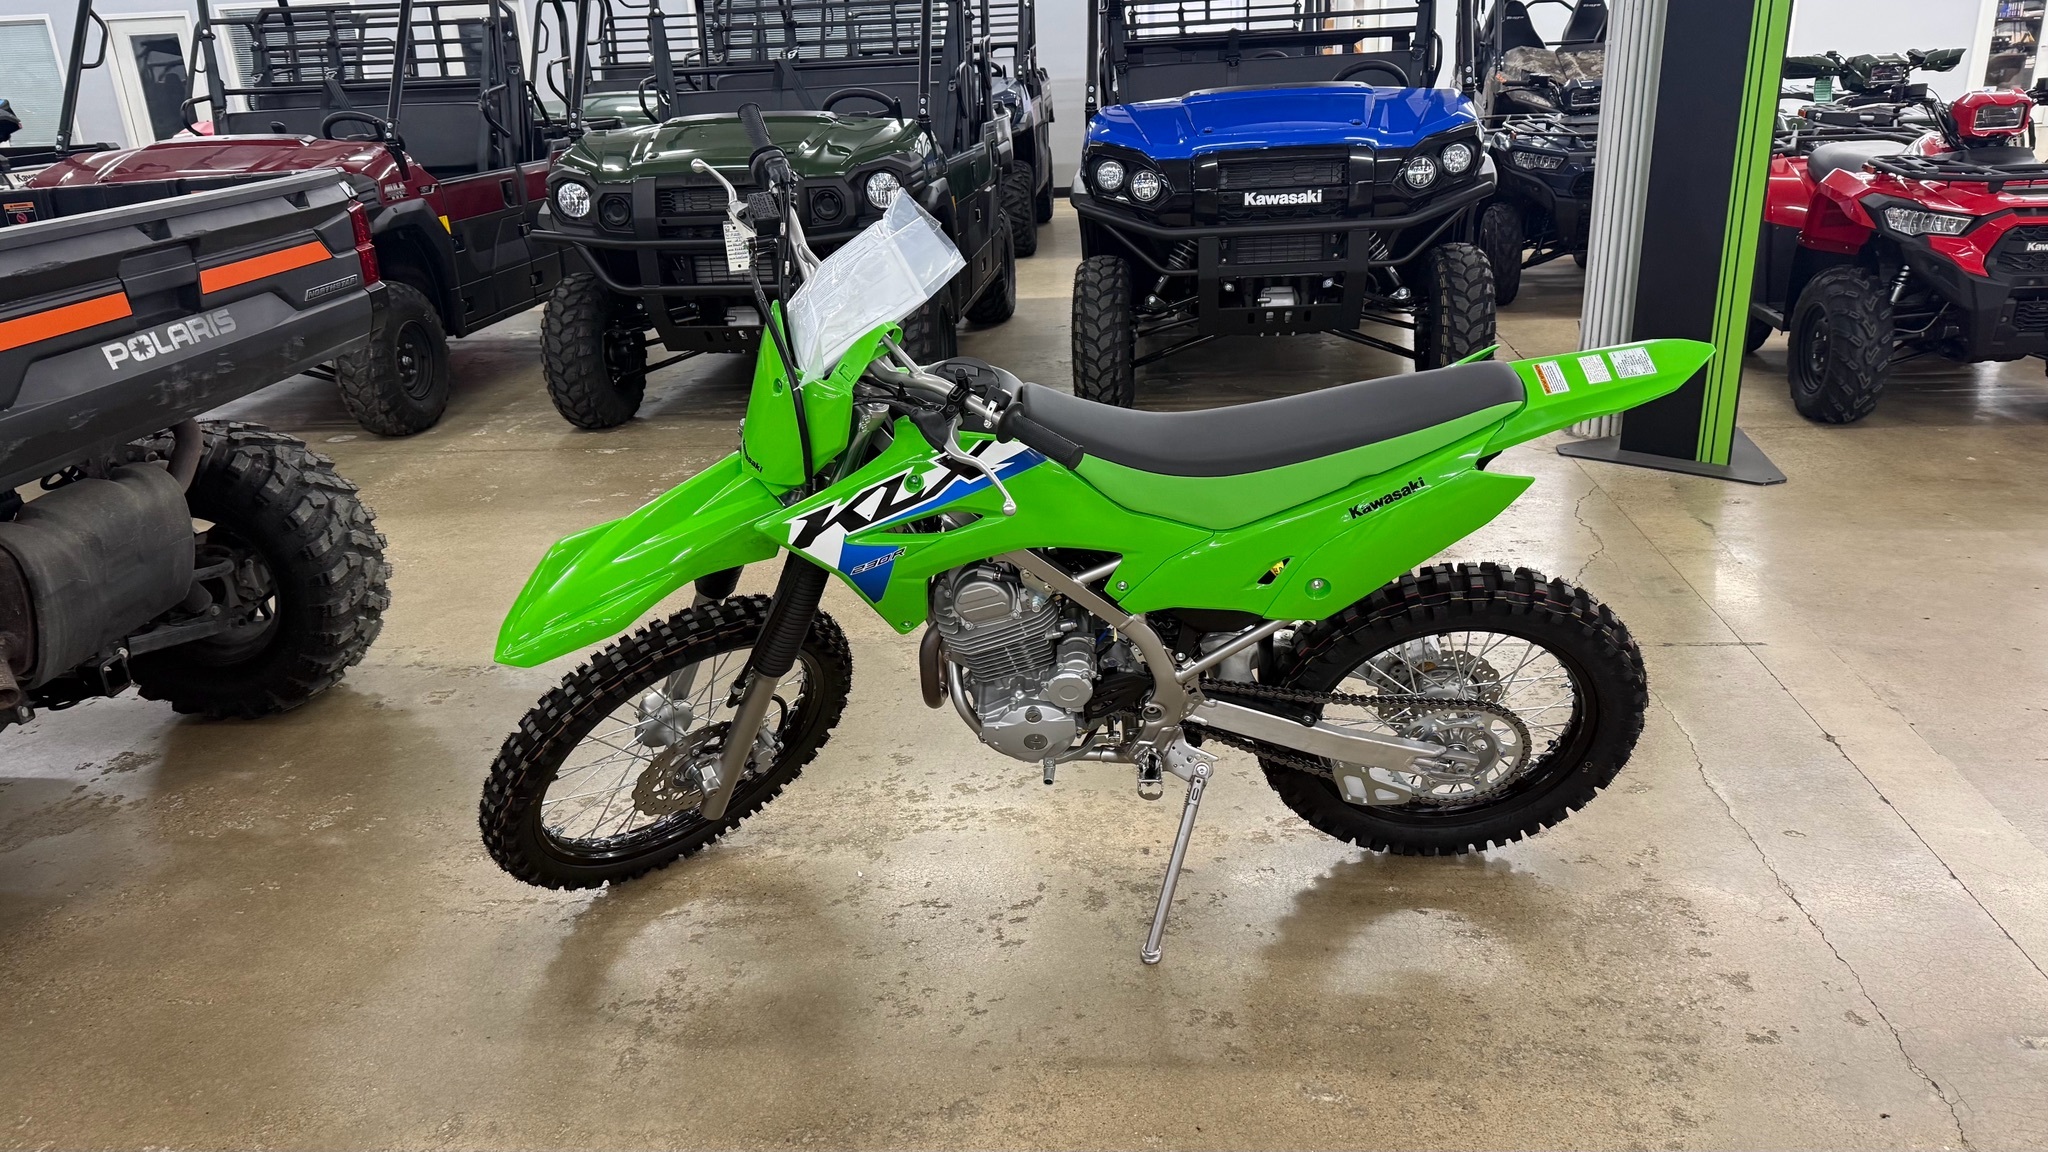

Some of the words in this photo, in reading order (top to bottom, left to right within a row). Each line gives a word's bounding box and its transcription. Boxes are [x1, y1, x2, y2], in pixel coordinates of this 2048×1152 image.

[1244, 189, 1322, 206] Kawasaki
[101, 308, 236, 370] POLARIS
[791, 439, 1004, 550] KLX
[1348, 476, 1426, 519] Kawasaki
[850, 546, 907, 576] 230R
